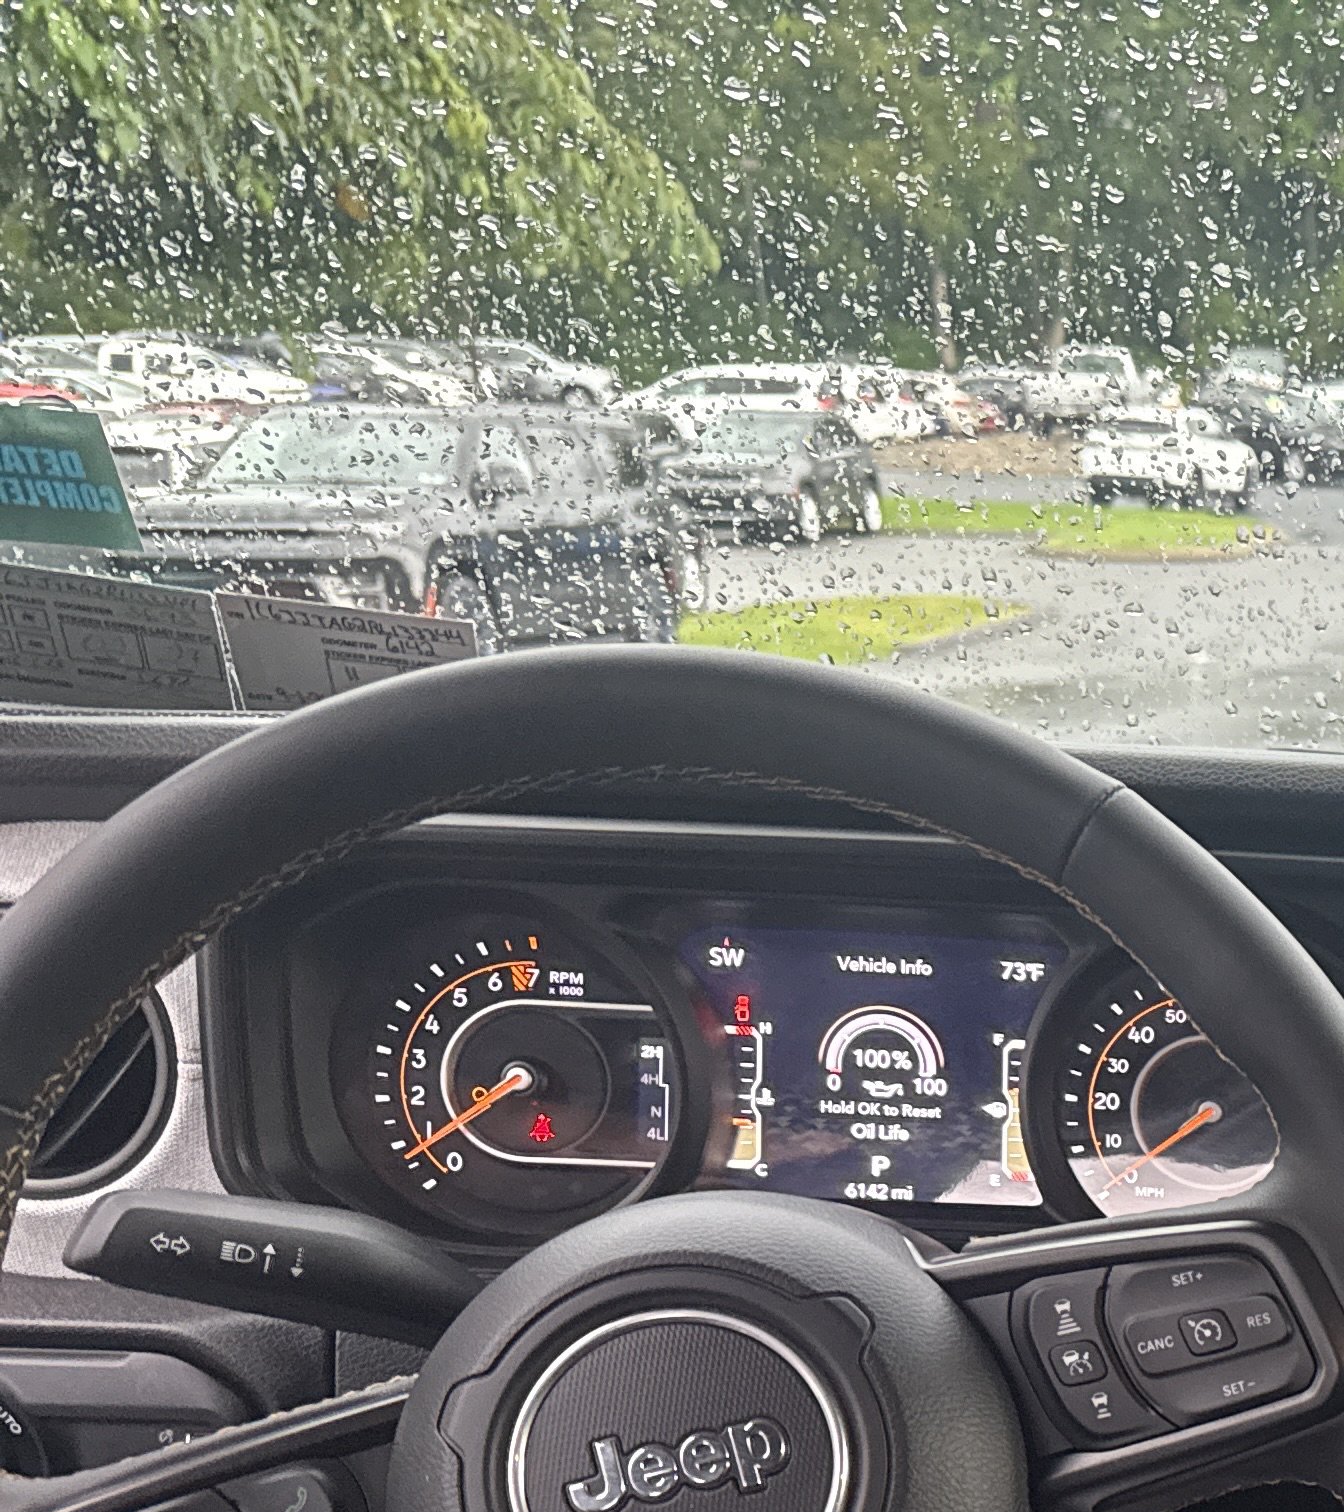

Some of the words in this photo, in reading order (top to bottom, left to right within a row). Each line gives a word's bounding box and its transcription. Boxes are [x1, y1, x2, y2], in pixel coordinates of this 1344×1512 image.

[385, 634, 438, 658] 6142
[708, 947, 746, 967] SW
[837, 955, 897, 974] Vehicle
[900, 959, 933, 976] Info
[488, 972, 503, 992] 6
[526, 967, 540, 989] 7
[549, 970, 584, 985] RPM
[452, 988, 468, 1007] 5
[559, 986, 584, 997] 1000
[424, 1015, 440, 1034] 4
[1165, 1010, 1187, 1024] 50
[1127, 1026, 1154, 1044] 40
[411, 1050, 426, 1069] 3
[853, 1050, 912, 1070] 100%
[1107, 1058, 1129, 1074] 30
[826, 1074, 842, 1091] 0
[913, 1077, 948, 1097] 100
[411, 1087, 426, 1106] 2
[1094, 1092, 1120, 1110] 20
[650, 1105, 662, 1118] N
[820, 1101, 855, 1116] Hold
[857, 1103, 880, 1116] OK
[883, 1104, 899, 1117] to
[902, 1105, 941, 1120] Reset
[851, 1124, 875, 1140] Oil
[878, 1125, 910, 1141] Life
[1105, 1134, 1122, 1149] 10
[446, 1152, 463, 1172] 0
[870, 1155, 890, 1178] P
[844, 1182, 888, 1200] 6142
[891, 1186, 913, 1200] mi
[1135, 1186, 1164, 1199] MPH
[1246, 1311, 1272, 1329] RES
[1137, 1335, 1175, 1355] CANC
[0, 1406, 22, 1434] UTO
